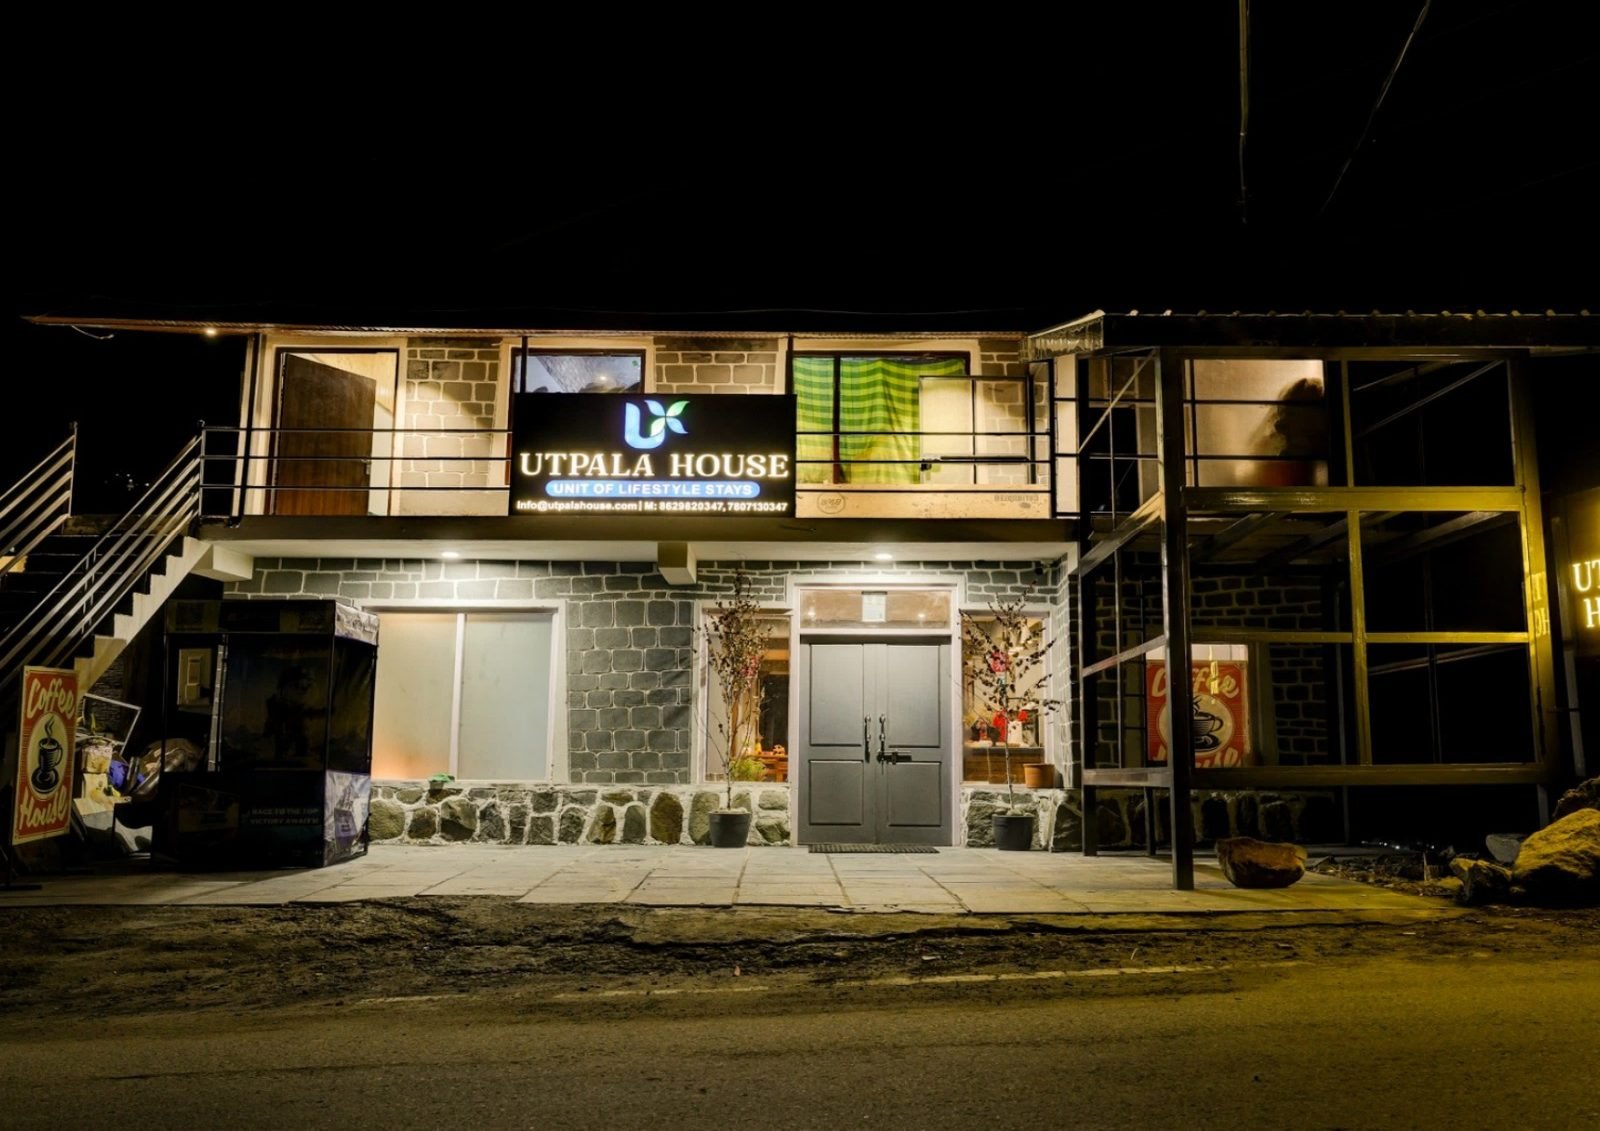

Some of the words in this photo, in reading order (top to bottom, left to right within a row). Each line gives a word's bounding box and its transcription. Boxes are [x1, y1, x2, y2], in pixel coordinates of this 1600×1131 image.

[520, 452, 655, 477] UTPALA
[671, 452, 789, 477] HOUSE
[554, 482, 588, 495] UNIT
[593, 482, 613, 495] OF
[619, 482, 701, 496] LIFESTYLE
[705, 482, 753, 496] STAYS
[28, 677, 76, 718] Coffee
[19, 787, 68, 830] House
